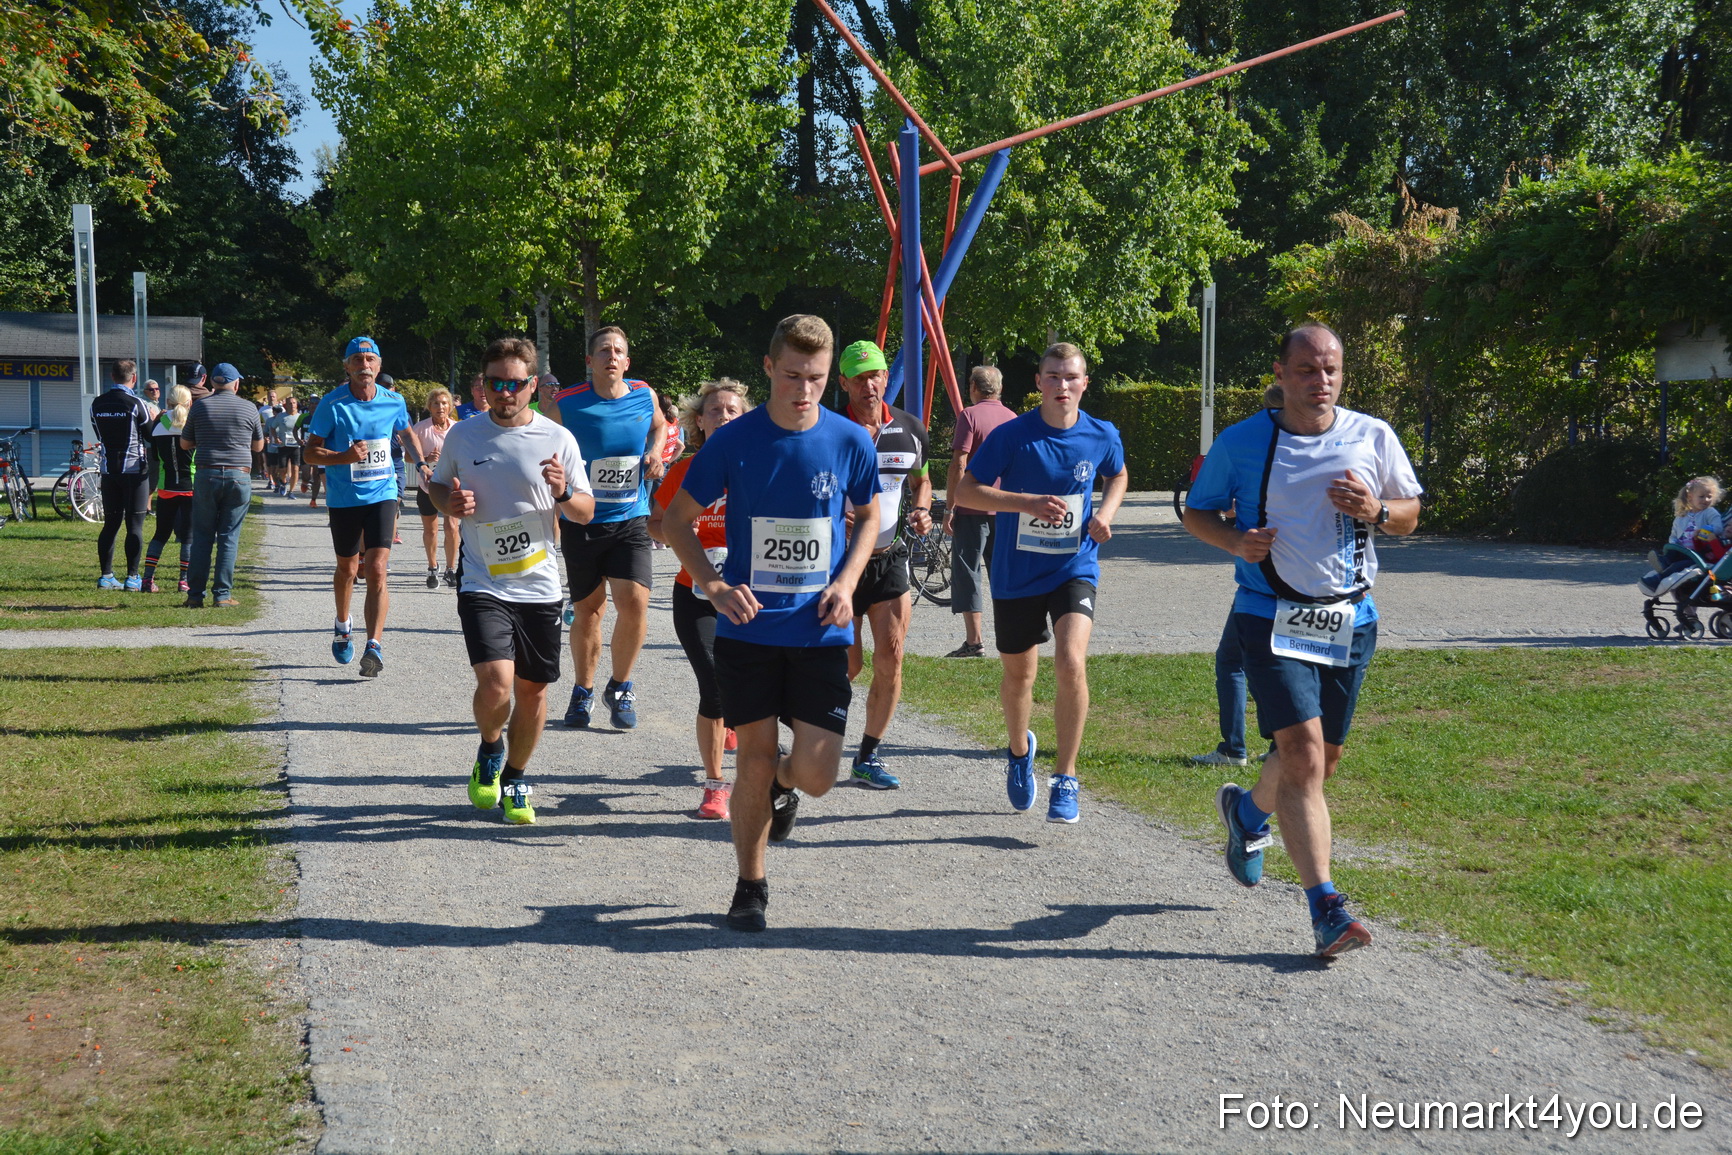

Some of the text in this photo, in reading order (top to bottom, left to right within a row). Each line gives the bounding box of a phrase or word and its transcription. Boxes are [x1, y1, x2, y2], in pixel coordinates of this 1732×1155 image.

[23, 364, 69, 377] KIOSK
[597, 469, 633, 484] 2252
[775, 525, 810, 533] BOCK
[1335, 512, 1343, 536] WASTE
[494, 531, 531, 556] 329
[763, 538, 820, 562] 2590
[1039, 539, 1061, 547] Kevin
[1345, 513, 1353, 586] ECHNOLOGY
[1286, 605, 1343, 633] 2499
[1289, 639, 1331, 655] Bernhard
